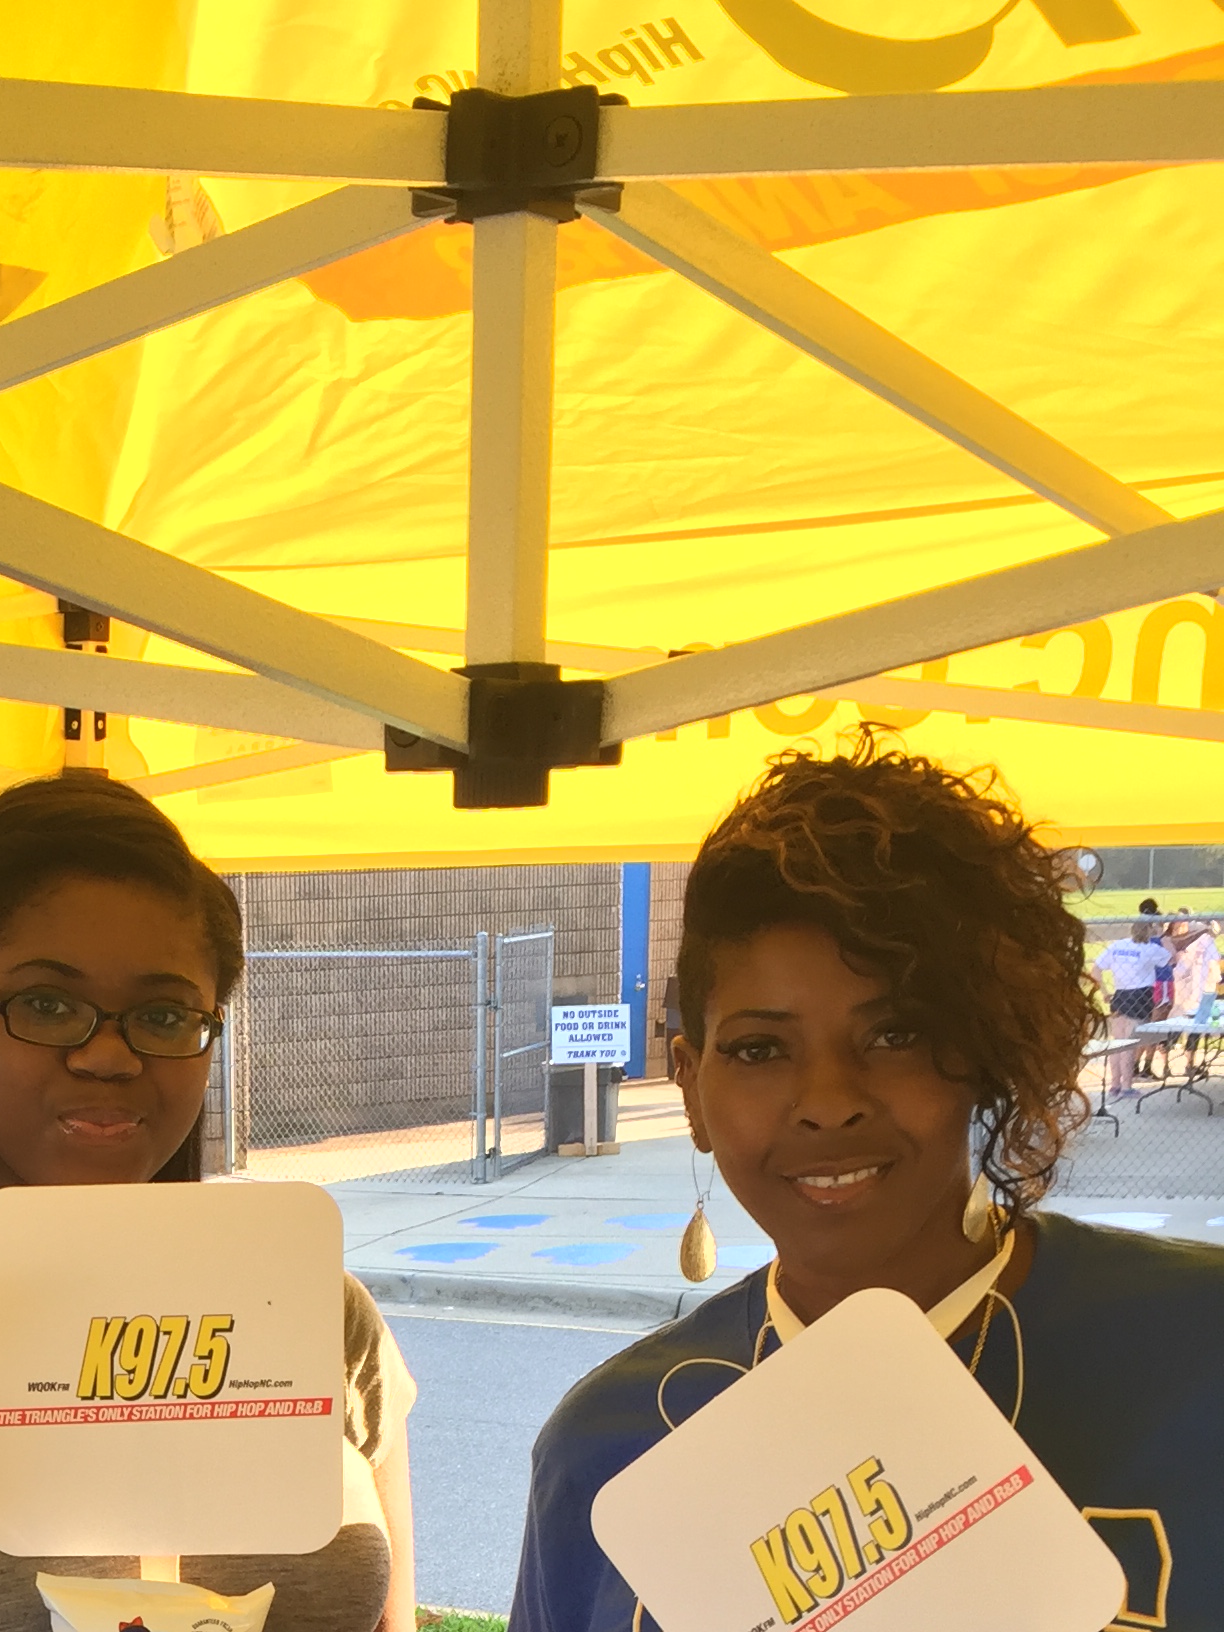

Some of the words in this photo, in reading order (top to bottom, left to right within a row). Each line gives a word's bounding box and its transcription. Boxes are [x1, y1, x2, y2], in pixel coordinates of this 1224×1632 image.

[562, 1010, 575, 1019] NO
[578, 1009, 619, 1019] OUTSIDE
[554, 1022, 579, 1031] FOOD
[582, 1021, 594, 1030] OR
[597, 1021, 627, 1030] DRINK
[568, 1033, 613, 1042] ALLOWED
[567, 1049, 597, 1059] THANK
[599, 1049, 617, 1058] YOU
[76, 1314, 235, 1400] K97.5
[229, 1379, 293, 1390] HipHopNC.com
[25, 1408, 97, 1424] TRIANGLE'S
[98, 1406, 132, 1421] ONLY
[131, 1405, 184, 1421] STATION
[185, 1404, 211, 1418] FOR
[213, 1403, 236, 1417] HIP
[237, 1402, 265, 1416] HOP
[265, 1401, 294, 1416] AND
[295, 1400, 324, 1415] R&B
[750, 1455, 914, 1625] K97.5
[814, 1601, 845, 1632] ONLY
[843, 1570, 894, 1611] STATION
[891, 1547, 920, 1577] FOR
[917, 1532, 940, 1559] HIP
[939, 1513, 967, 1543] HOP
[966, 1493, 996, 1523] AND
[993, 1473, 1024, 1503] R&B
